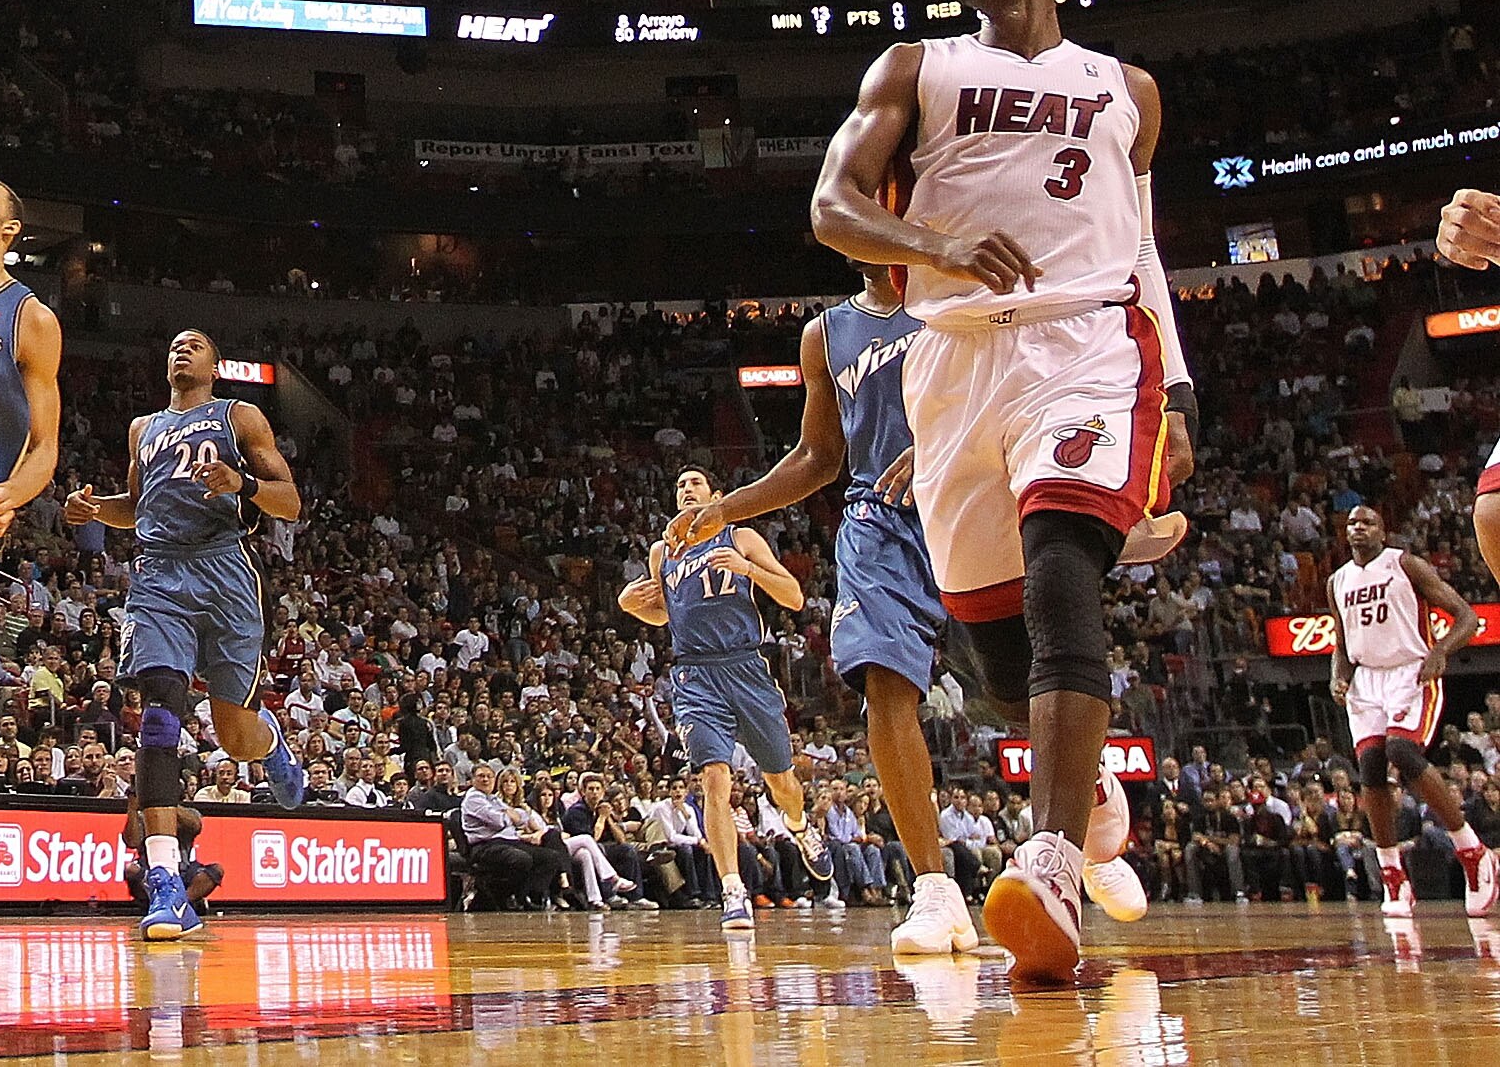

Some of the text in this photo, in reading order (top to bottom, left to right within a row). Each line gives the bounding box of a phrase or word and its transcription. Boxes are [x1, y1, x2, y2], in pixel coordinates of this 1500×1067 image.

[457, 13, 555, 42] HEAT
[638, 14, 685, 30] Arroyo
[771, 14, 803, 30] MIN
[847, 10, 881, 26] PTS
[926, 1, 962, 20] REB
[638, 26, 699, 42] Anthony
[955, 88, 1114, 140] HEAT
[421, 141, 492, 158] Report
[578, 145, 637, 158] Fans!
[646, 142, 696, 156] Text
[1262, 153, 1311, 177] Health
[1315, 150, 1350, 168] care
[1354, 139, 1385, 163] and
[1389, 141, 1408, 156] so
[1412, 128, 1454, 153] much
[1043, 147, 1092, 201] 3
[217, 359, 262, 383] ARDI
[741, 369, 797, 383] BACARDI
[836, 331, 917, 399] WIZA
[140, 419, 223, 467] WIZARDS
[171, 439, 219, 479] 20
[699, 567, 738, 599] 12
[1344, 577, 1394, 608] HEAT
[1361, 602, 1388, 627] 50
[26, 830, 112, 882] State
[289, 836, 429, 884] State Farm
